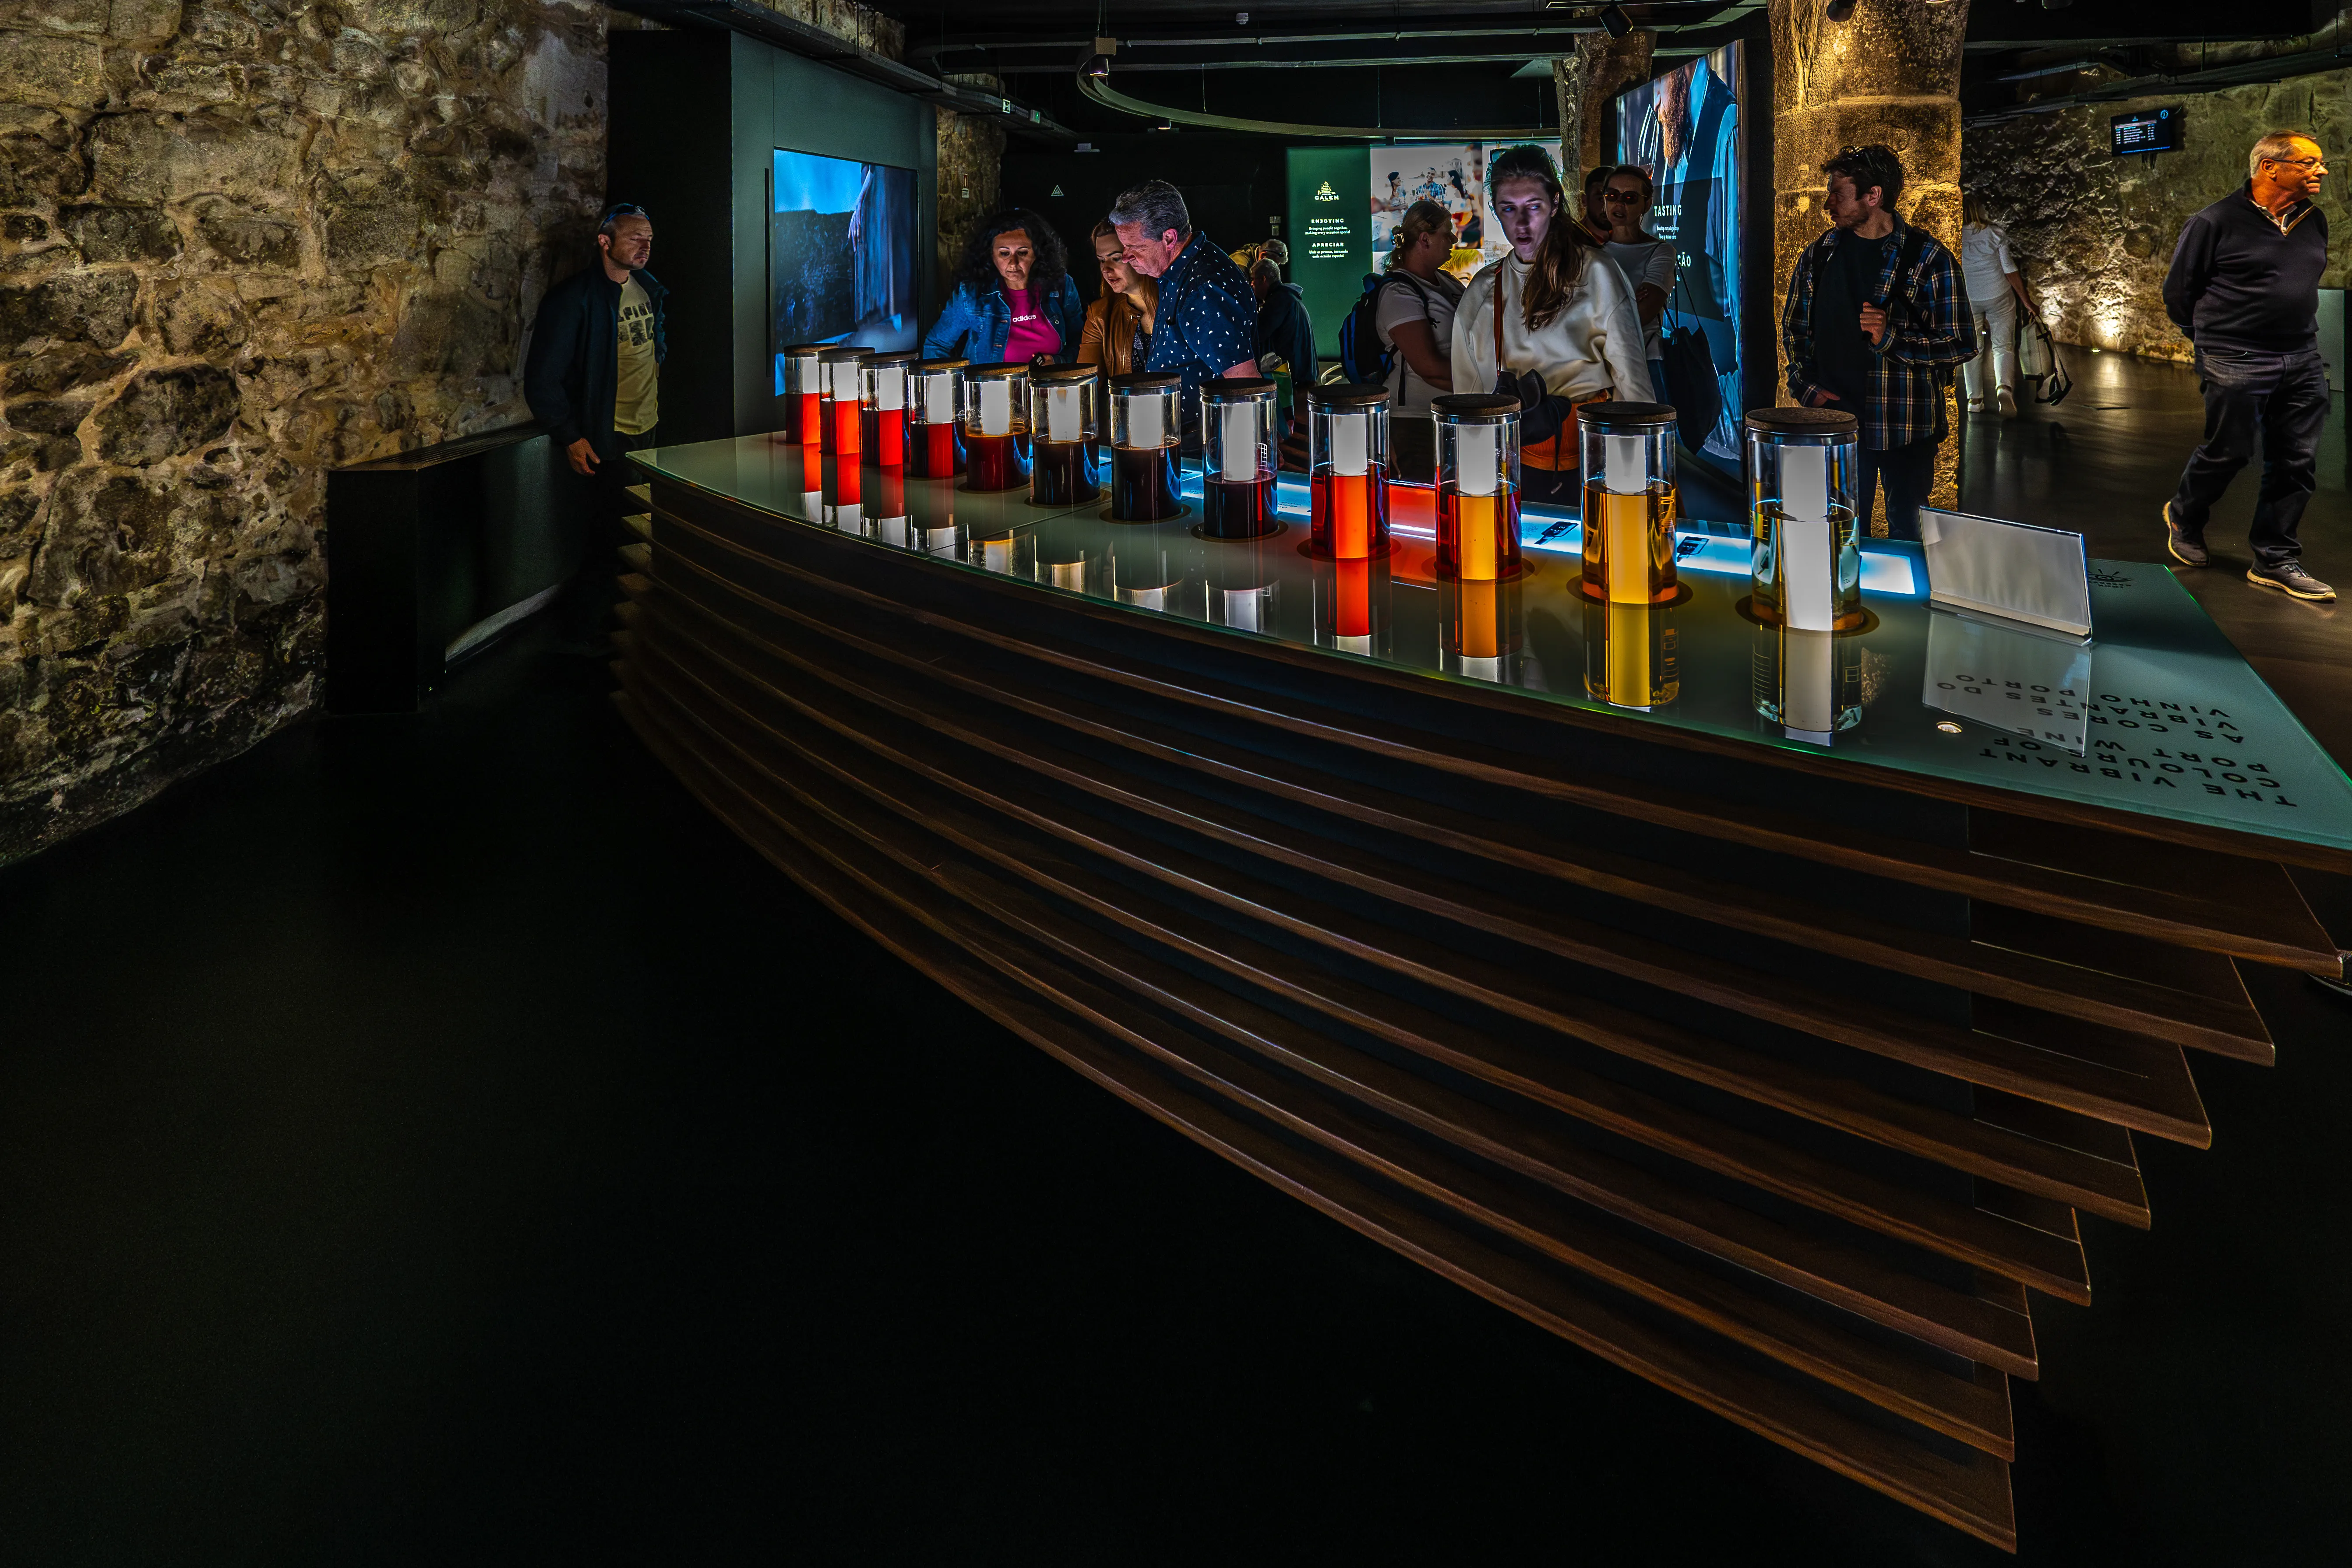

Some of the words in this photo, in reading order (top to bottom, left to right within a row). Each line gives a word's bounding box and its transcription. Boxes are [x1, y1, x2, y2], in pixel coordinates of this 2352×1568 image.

[1654, 204, 1682, 216] TASTING
[1937, 682, 1982, 694] DO
[1955, 674, 2075, 697] PORTO
[2006, 692, 2239, 731] VIBRANTES
[2100, 694, 2230, 718] VINHO
[2036, 708, 2169, 733] CORES
[1994, 737, 2042, 751] OF
[2017, 727, 2126, 751] WINE
[2194, 730, 2244, 743] AS
[1979, 748, 2176, 788] VIBRANT
[2068, 748, 2280, 788] COLOURS
[2152, 748, 2270, 773] PORT
[2202, 783, 2297, 807] THE
